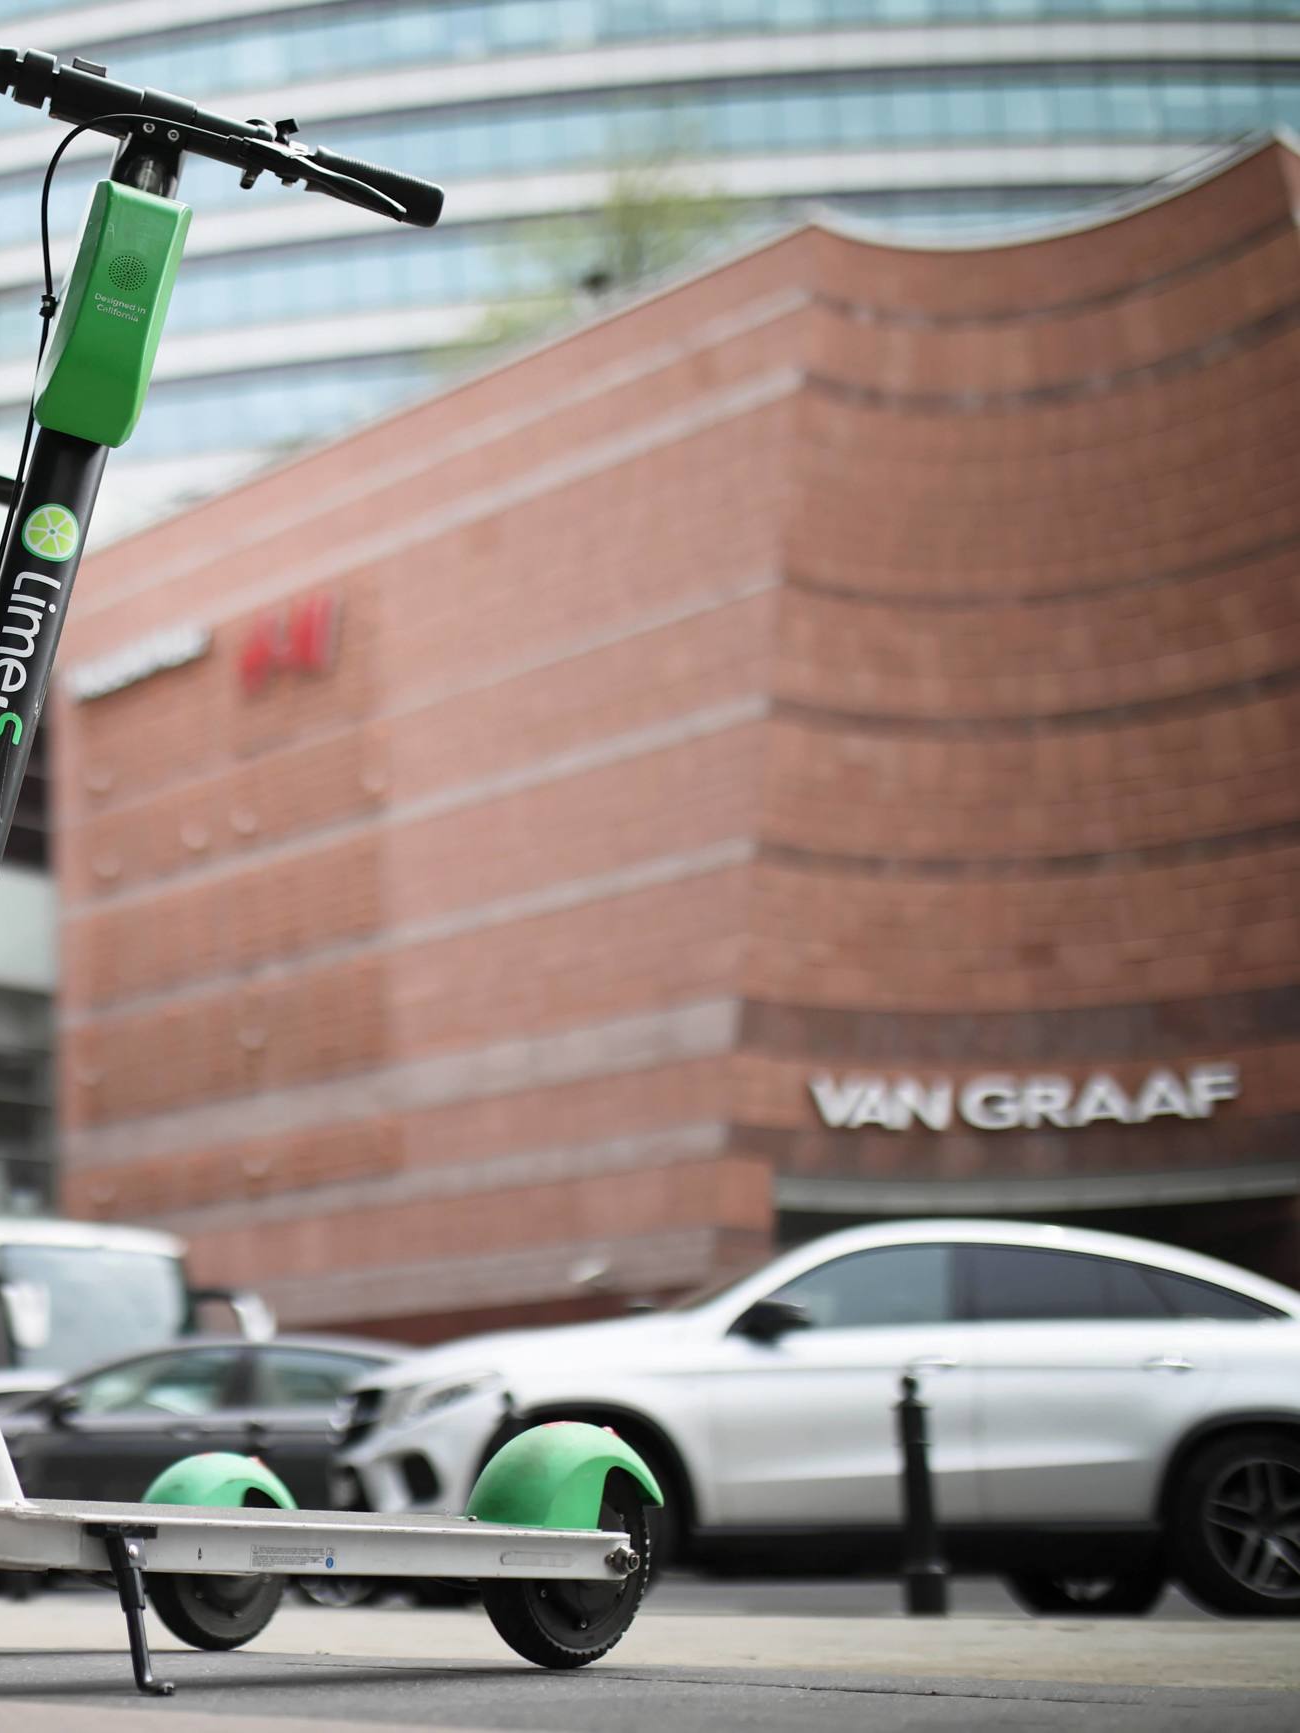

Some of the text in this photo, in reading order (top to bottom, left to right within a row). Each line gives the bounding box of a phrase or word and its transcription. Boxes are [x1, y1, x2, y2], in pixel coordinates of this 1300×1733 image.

[94, 292, 147, 315] Designed in
[96, 303, 140, 323] California
[808, 1060, 1241, 1132] VAN GRAAF
